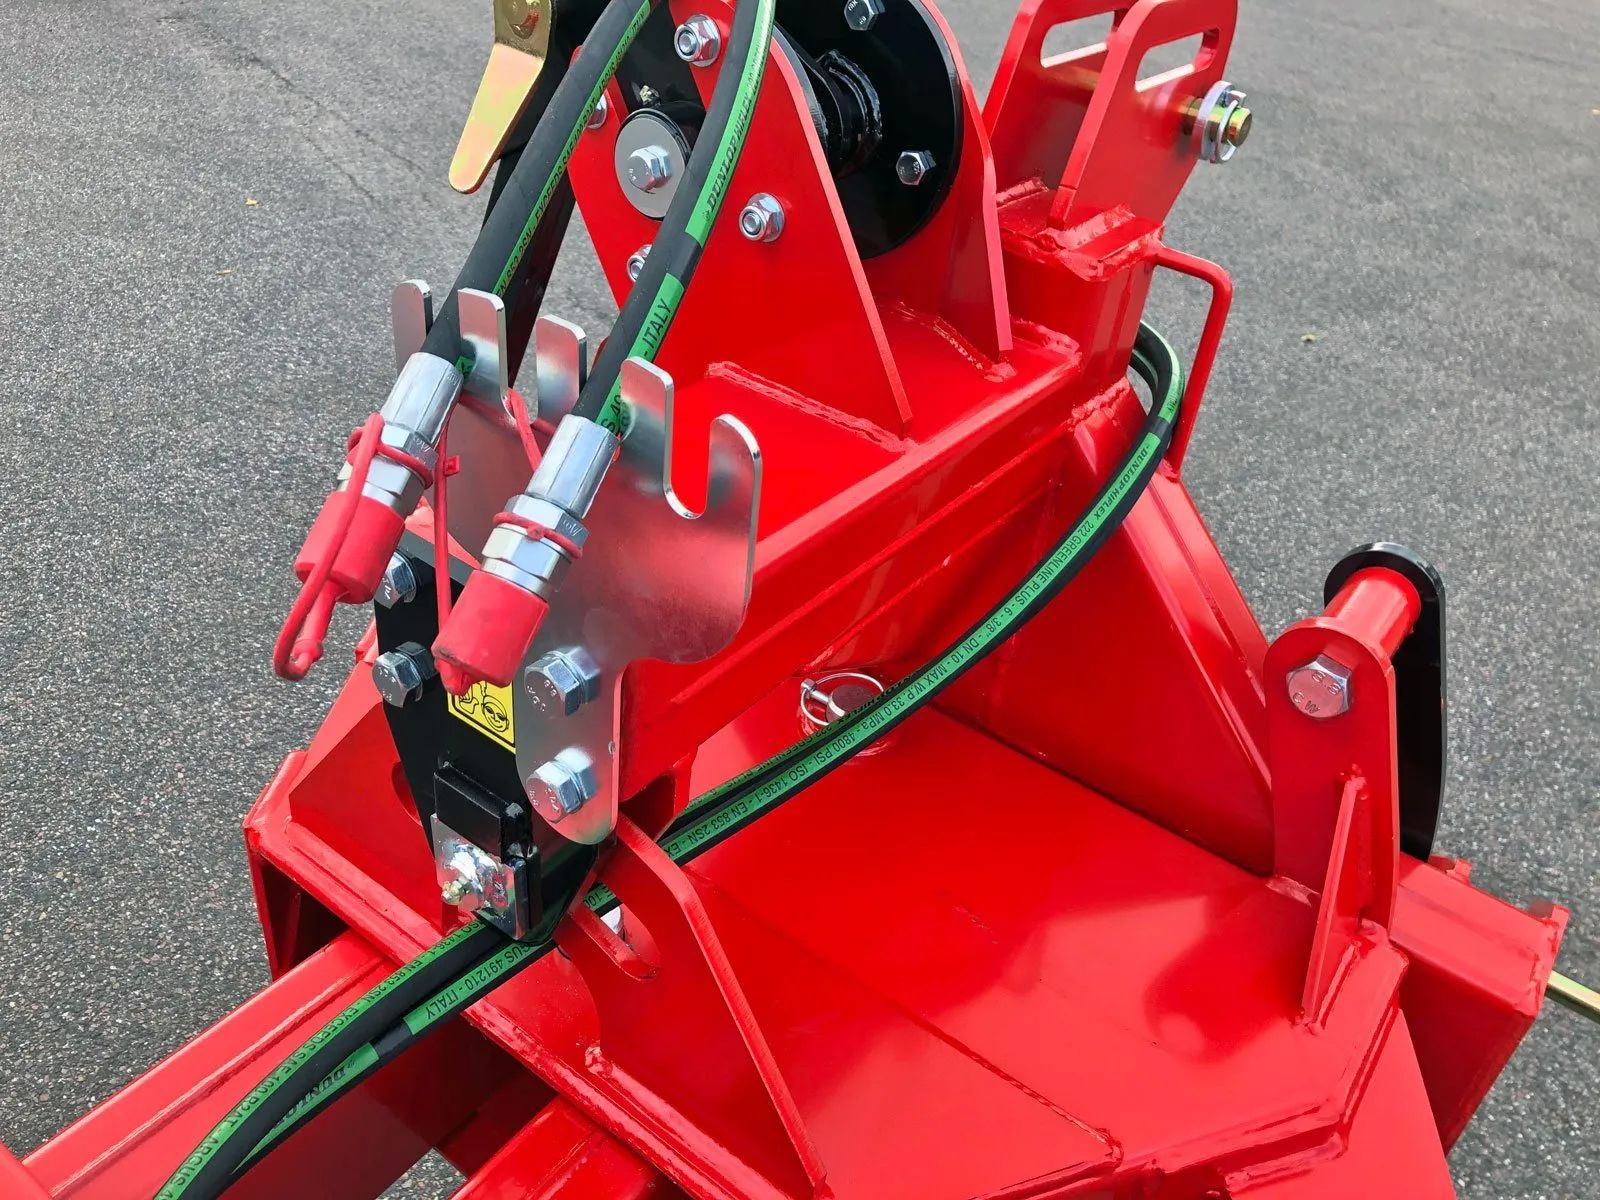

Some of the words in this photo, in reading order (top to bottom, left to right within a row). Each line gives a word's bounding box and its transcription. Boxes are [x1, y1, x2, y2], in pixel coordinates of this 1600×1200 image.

[708, 138, 739, 213] DUNLOP
[642, 298, 672, 350] ITALY
[1117, 448, 1149, 494] DUNLOP
[1093, 490, 1120, 521] HIFLEX
[1078, 520, 1095, 536] 222
[1039, 535, 1083, 584] GREENLINE
[1015, 580, 1041, 606] PLUS
[1003, 607, 1014, 617] 6
[963, 637, 980, 655] DN
[951, 653, 964, 664] 10
[924, 664, 949, 686] MAX
[884, 697, 906, 717] 33.0
[860, 711, 886, 731] MPa
[832, 732, 857, 753] 4800
[815, 749, 834, 765] PSI
[788, 764, 809, 783] ISO
[755, 777, 789, 804] 1436-1
[731, 802, 749, 818] EN
[710, 812, 732, 830] 853
[687, 824, 711, 845] 2SN
[407, 959, 423, 973] EN
[464, 961, 504, 992] 491210
[362, 985, 387, 1003] 2SN
[426, 993, 459, 1020] ITALY
[303, 1007, 360, 1052] EXCEEDS
[279, 1049, 307, 1074] SAE
[259, 1076, 281, 1094] 100
[227, 1095, 259, 1129] R2AT
[171, 1134, 220, 1187] ARGUS
